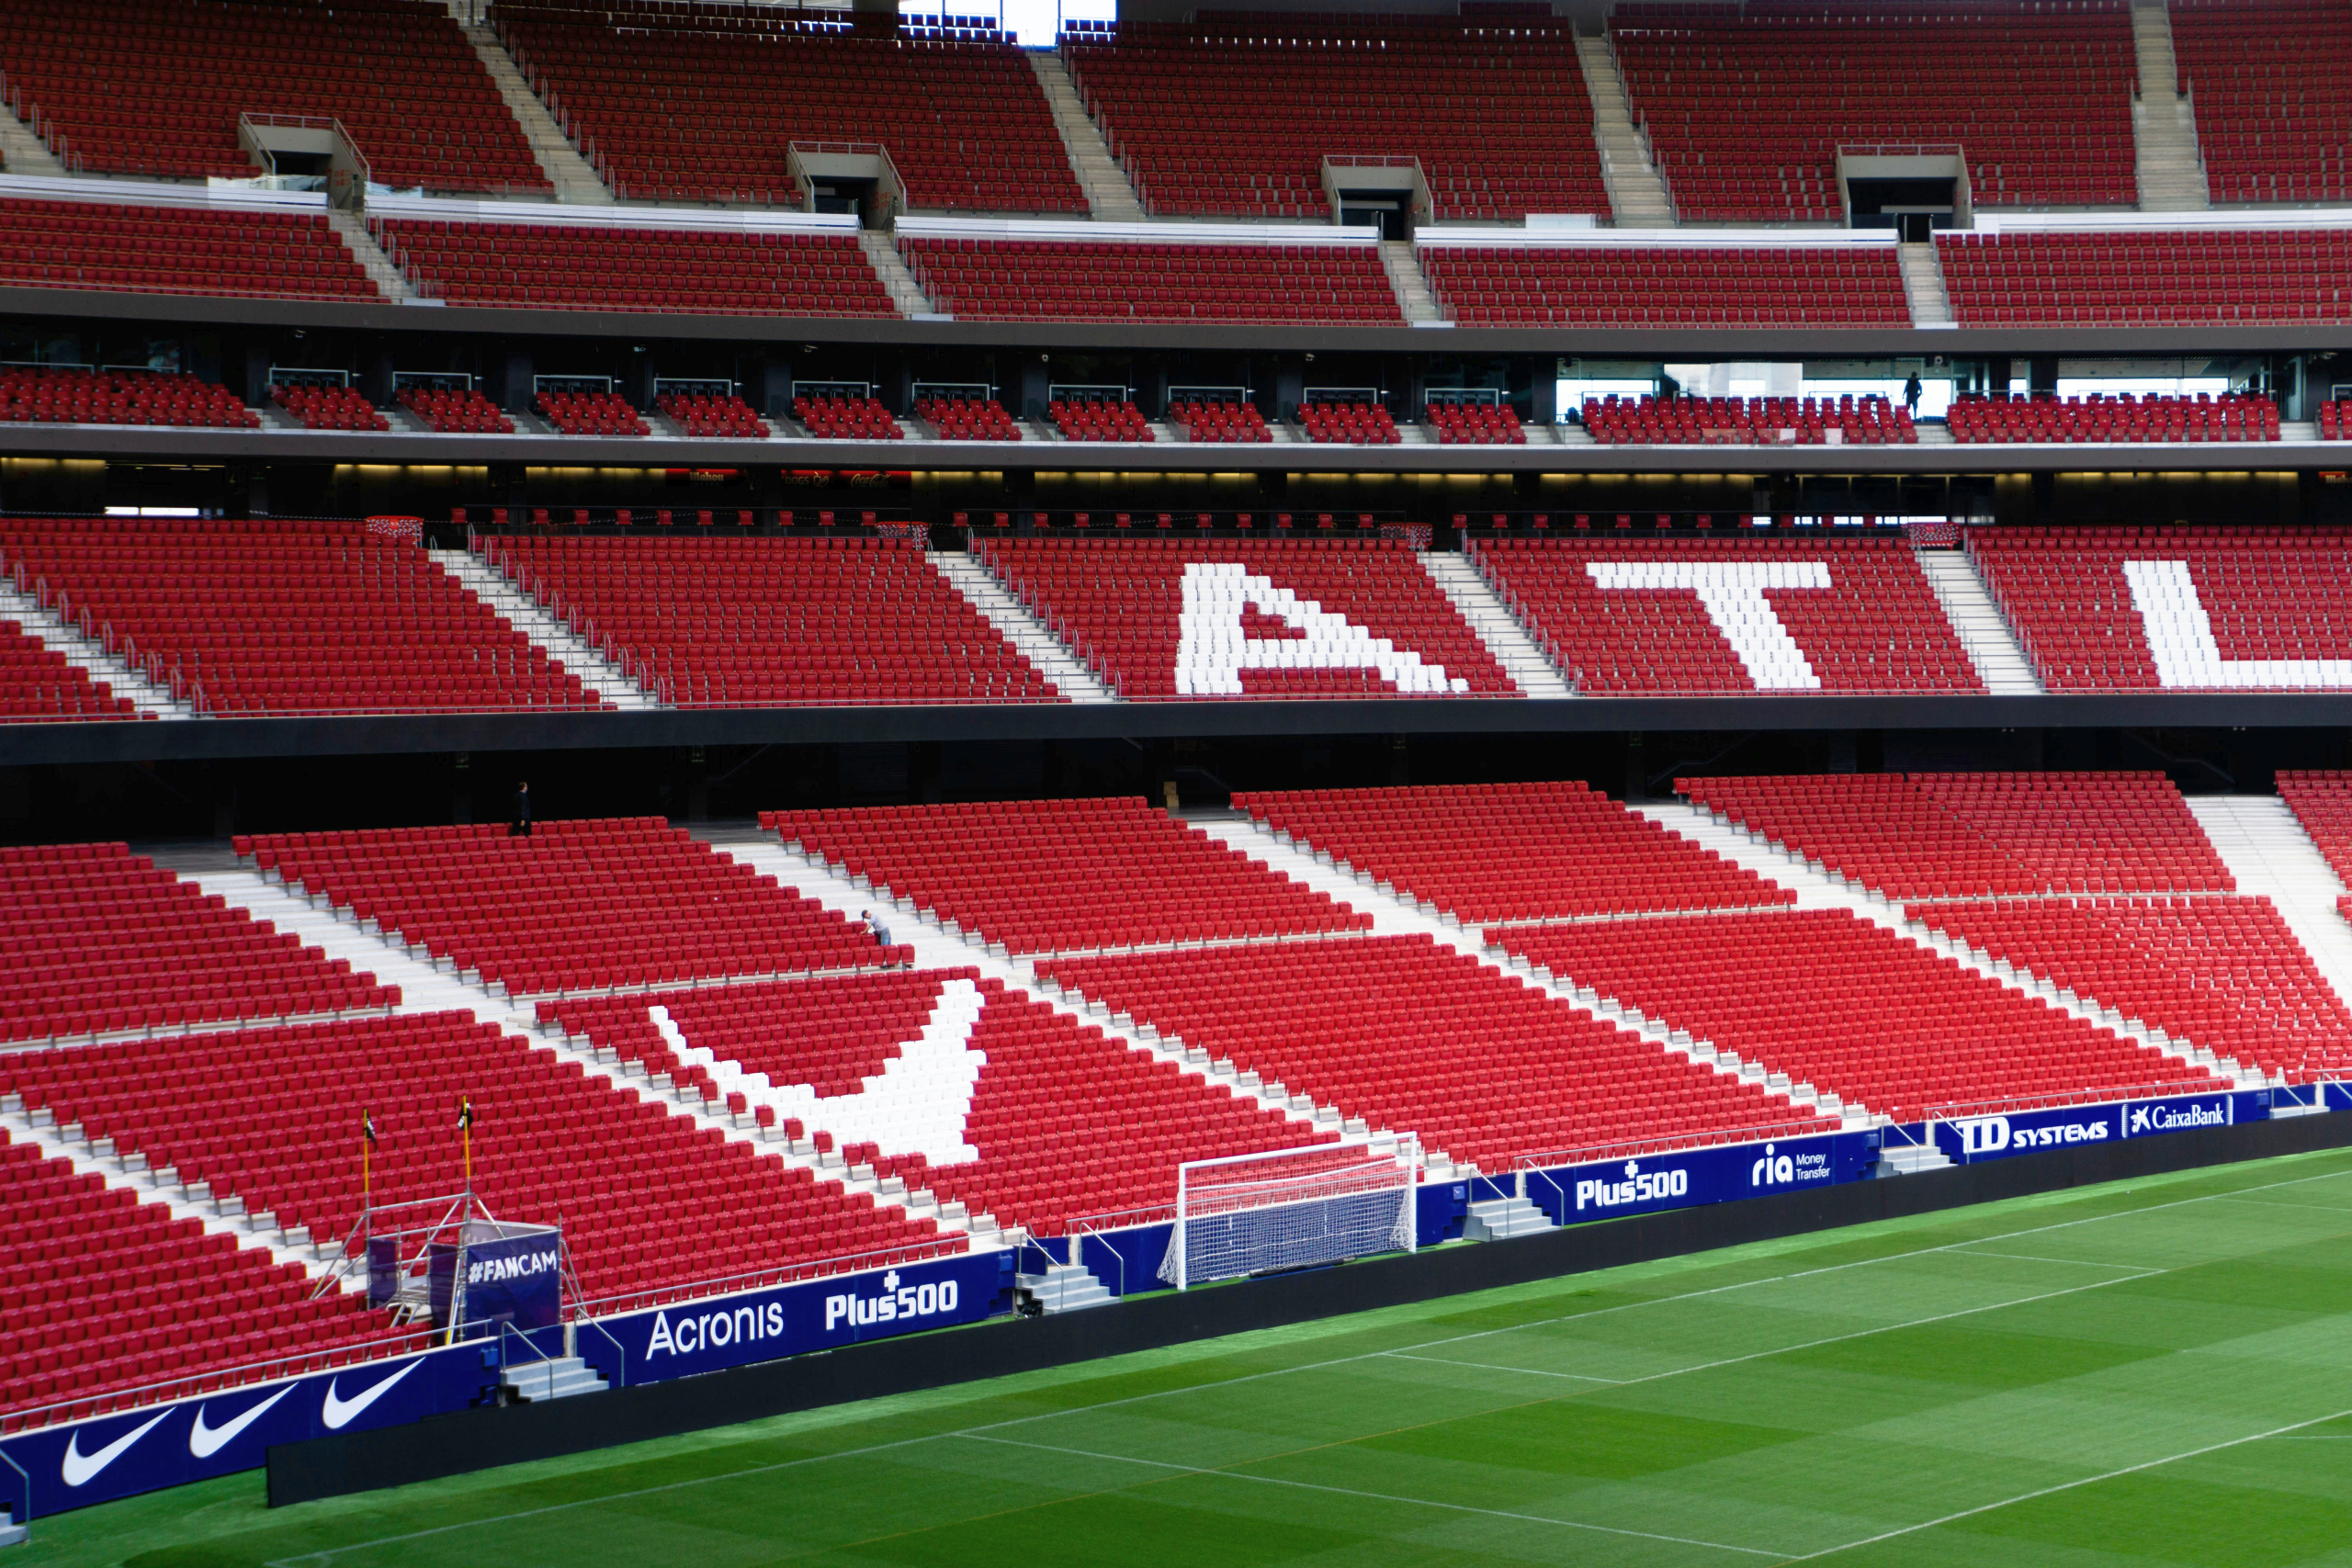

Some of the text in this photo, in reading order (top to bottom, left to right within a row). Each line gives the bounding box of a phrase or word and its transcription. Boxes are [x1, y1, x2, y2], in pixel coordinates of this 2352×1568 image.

[689, 471, 725, 481] Mahou
[785, 476, 809, 486] DOGS
[2152, 1102, 2224, 1129] CaixaBank
[1955, 1116, 2109, 1155] TD SYSTEMS
[1752, 1143, 1793, 1186] ria
[1795, 1154, 1826, 1166] Money
[1795, 1166, 1831, 1181] Transfer
[1577, 1168, 1688, 1210] Plus500
[468, 1249, 558, 1284] #FANCAM
[826, 1280, 958, 1330] Plus500
[645, 1302, 784, 1360] Acronis
